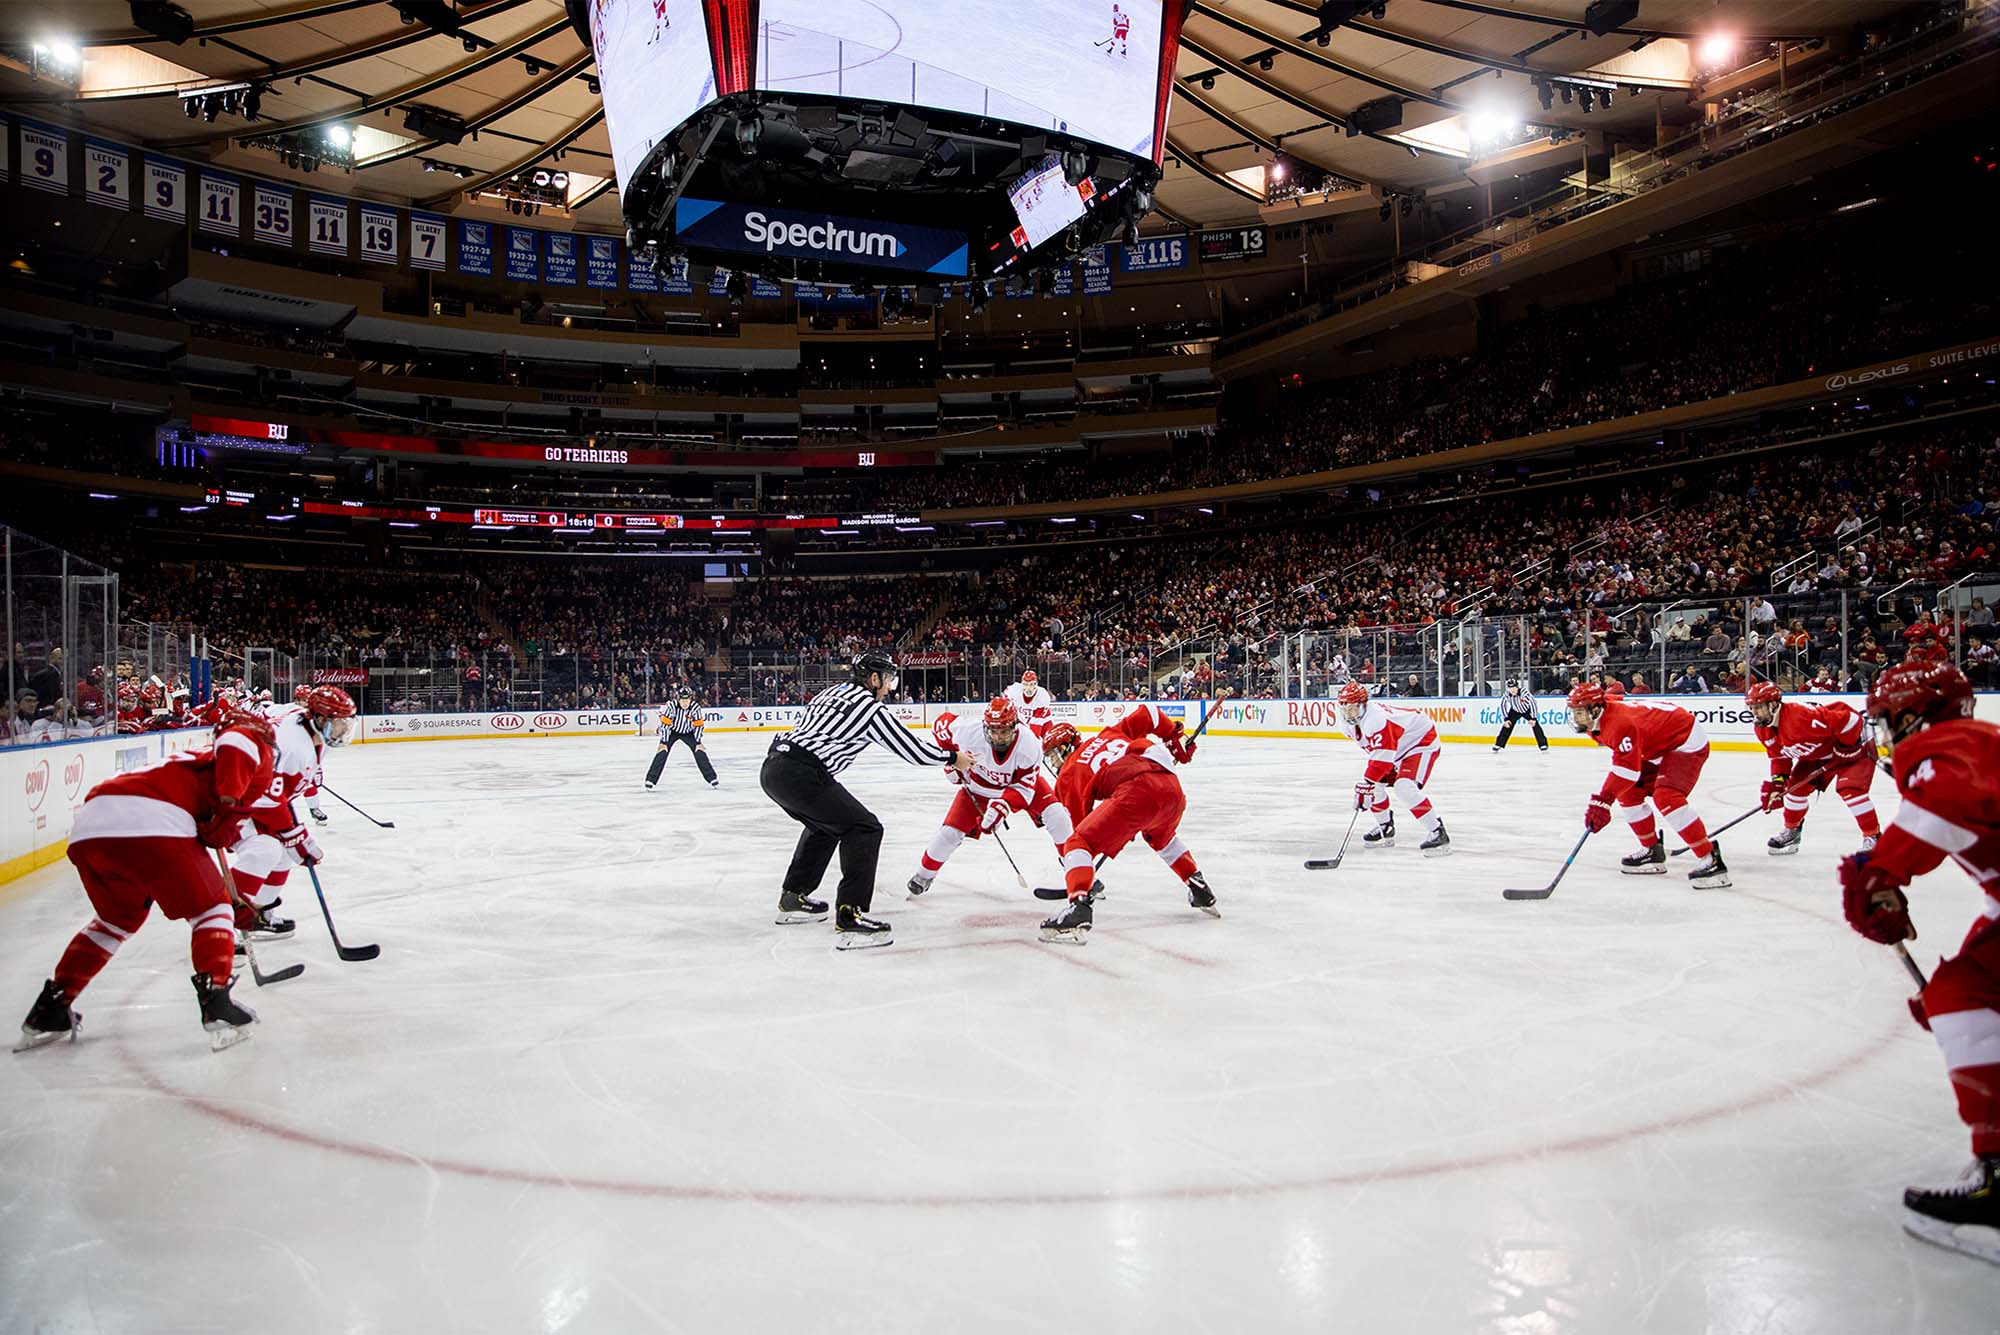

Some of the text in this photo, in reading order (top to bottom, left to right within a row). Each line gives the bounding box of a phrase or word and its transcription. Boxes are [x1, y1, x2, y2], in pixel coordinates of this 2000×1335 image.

[35, 148, 54, 178] 9
[92, 152, 122, 168] LEETCH
[99, 165, 116, 194] 2
[157, 180, 173, 208] 9
[207, 194, 232, 223] 11
[257, 205, 290, 233] 35
[317, 217, 340, 243] 11
[366, 225, 393, 251] 19
[744, 211, 898, 258] Spectrum
[1202, 231, 1232, 243] PHISH
[420, 233, 437, 258] 7
[1239, 229, 1264, 250] 13
[1128, 254, 1147, 266] JOEL
[1148, 239, 1183, 265] 116
[1459, 257, 1490, 277] CHASE
[1848, 343, 2000, 385] LEXUS SUITE LEVE
[268, 424, 289, 440] BU
[545, 448, 628, 464] GO TERRIERS
[858, 453, 875, 467] BU
[430, 512, 437, 520] 0
[549, 514, 558, 525] 0
[604, 516, 613, 527] 0
[715, 520, 722, 528] 0
[313, 669, 365, 684] Budweiser
[423, 719, 481, 728] SQUARESPACE
[497, 717, 519, 727] KIA
[539, 716, 561, 726] KIA
[577, 714, 631, 726] CHASE
[753, 711, 803, 721] DELTA
[1287, 702, 1337, 727] RAO'S
[1421, 707, 1466, 723] NKIN'
[1693, 706, 1755, 724] prise
[934, 719, 950, 741] 25
[1076, 737, 1109, 765] LOCKE
[265, 776, 284, 797] 8
